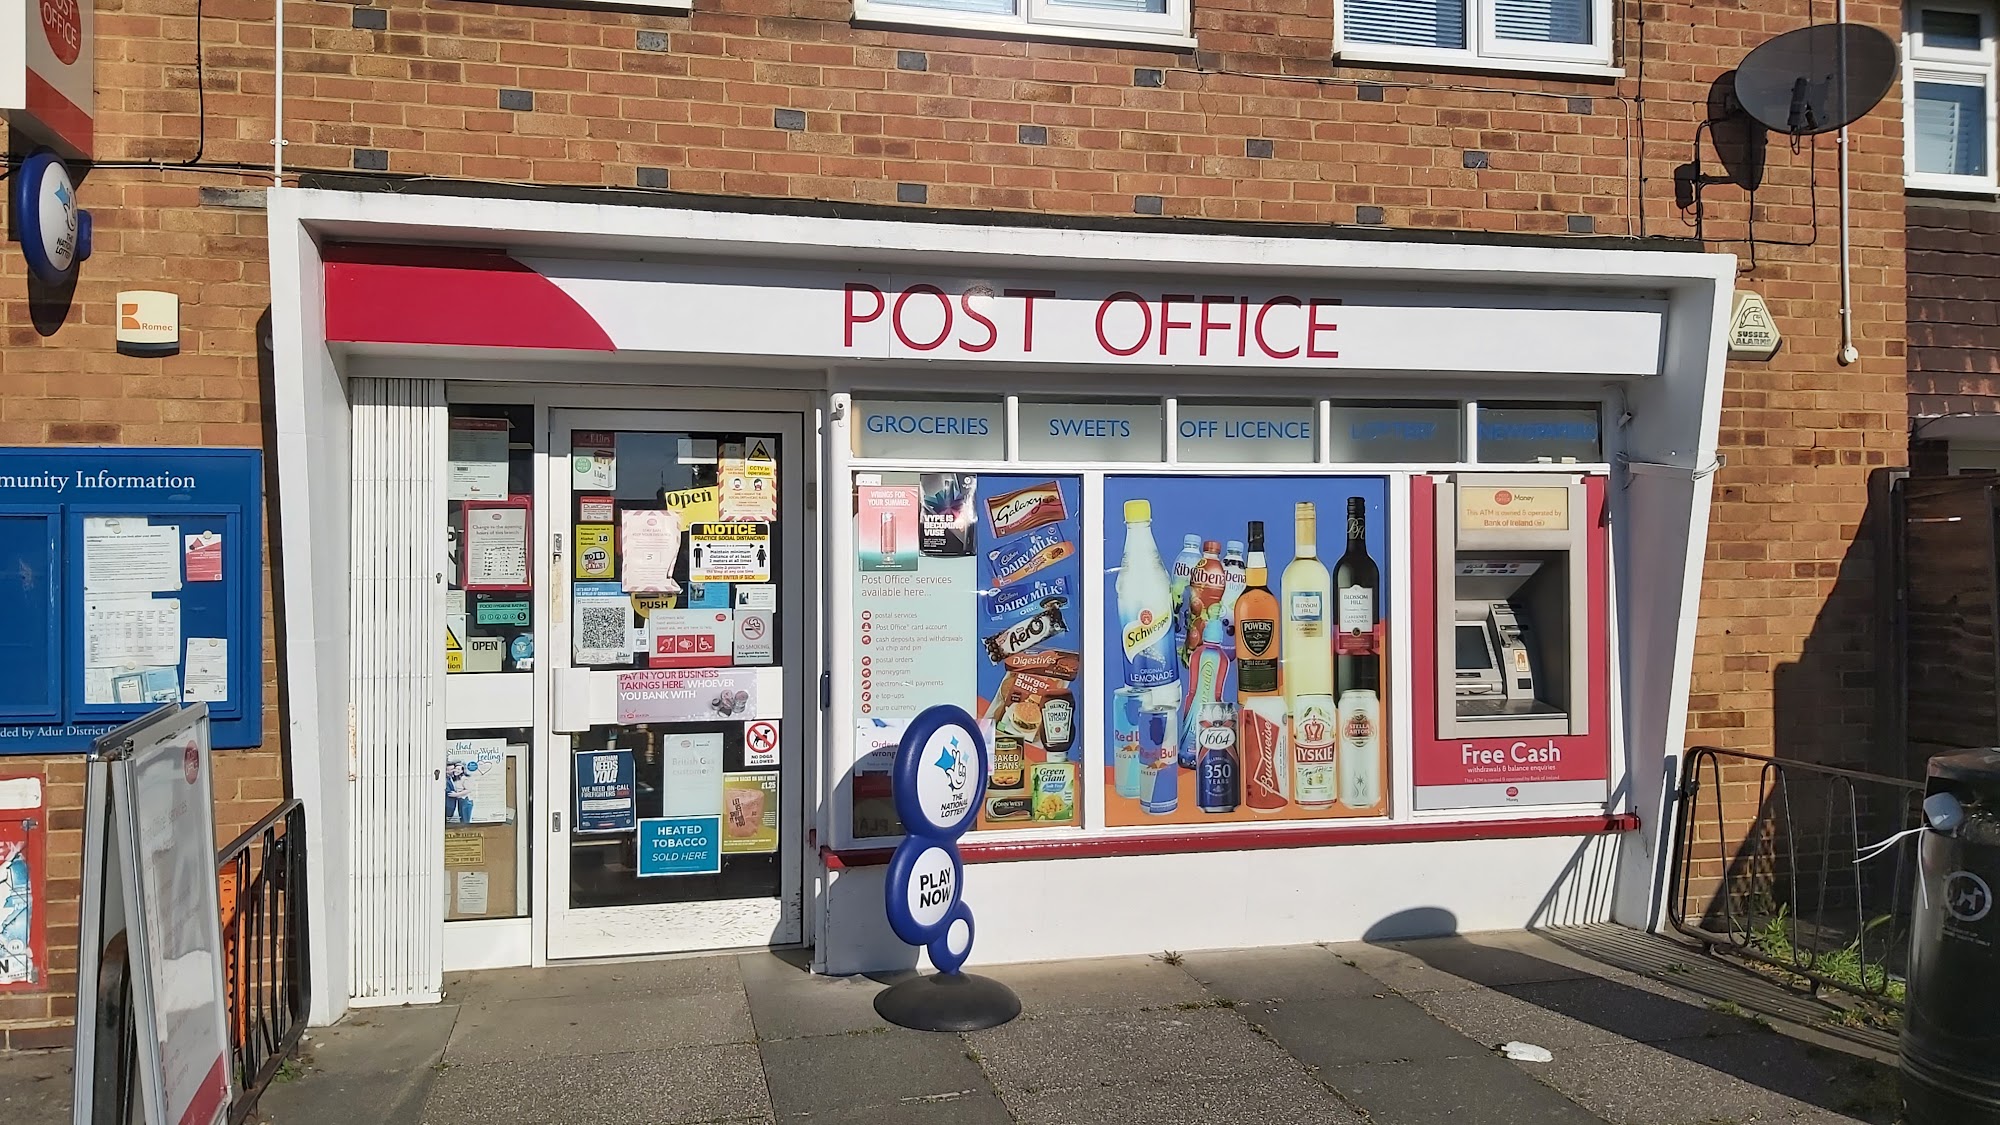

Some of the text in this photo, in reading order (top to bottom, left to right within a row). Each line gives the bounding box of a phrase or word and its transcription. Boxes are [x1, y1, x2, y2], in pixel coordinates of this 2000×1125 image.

[43, 2, 77, 50] OFFICE
[844, 282, 1342, 359] POST OFFICE
[142, 322, 173, 331] Romec
[866, 415, 989, 436] GROCERIES
[1049, 418, 1131, 438] SWEETS
[1179, 420, 1310, 439] OFF LICENCE
[75, 470, 196, 489] Information
[667, 489, 713, 508] Open
[1513, 494, 1535, 503] Money
[993, 495, 1043, 525] Galaxy
[1527, 509, 1554, 517] operated
[1554, 509, 1562, 517] by
[923, 514, 945, 522] VYPE
[1483, 519, 1533, 527] Bank of Ireland
[703, 524, 757, 535] NOTICE
[1000, 551, 1030, 577] DAIRY
[1029, 535, 1059, 558] MILK
[861, 575, 882, 585] Post
[915, 575, 952, 584] services
[1190, 569, 1225, 585] Ribena
[861, 587, 932, 597] available here...
[640, 600, 669, 609] PUSH
[994, 586, 1063, 614] DAIRY MILK
[875, 611, 918, 620] postal services
[911, 623, 924, 631] card
[925, 623, 948, 631] account
[1244, 622, 1272, 632] POWERS
[891, 636, 916, 644] deposits
[472, 641, 498, 651] OPEN
[885, 645, 899, 653] chip
[875, 656, 914, 665] postal orders
[1012, 655, 1057, 667] Digestives
[619, 670, 719, 681] PAY IN YOUR BUSINESS
[875, 668, 911, 677] moneygram
[1130, 669, 1174, 682] LEMONADE
[1140, 667, 1163, 675] ORIGINAL
[620, 679, 734, 690] TAKINGS HERE, WHOEVER
[915, 679, 944, 687] payments
[1014, 679, 1039, 694] Buns
[1017, 672, 1050, 690] Burger
[620, 690, 696, 701] YOU BANK WITH
[881, 692, 905, 701] top-ups
[890, 704, 917, 713] currency
[21, 725, 34, 740] by
[36, 725, 64, 737] Adur
[66, 724, 106, 736] District
[1115, 729, 1133, 742] Red
[871, 740, 900, 749] Ordere
[1204, 733, 1231, 746] 1664
[447, 746, 499, 756] Slimming World
[455, 742, 472, 750] that
[871, 750, 896, 760] wrong
[1139, 745, 1177, 759] Red Bull
[1296, 744, 1334, 762] TYSKIE
[1462, 740, 1561, 765] Free Cash
[477, 752, 504, 764] feeling!
[672, 757, 698, 766] British
[994, 754, 1019, 762] BAKED
[1259, 720, 1273, 797] Budweise
[594, 760, 619, 771] NEEDS
[994, 762, 1019, 770] BEANS
[1467, 765, 1502, 773] withdrawals
[1530, 764, 1556, 773] enquiries
[593, 770, 618, 784] YOU!
[1039, 768, 1065, 776] Green
[1204, 764, 1231, 779] 350
[1041, 774, 1066, 783] Giant
[761, 782, 776, 790] £1.25
[581, 790, 616, 798] FIREFIGHTERS
[952, 792, 964, 801] THE
[940, 798, 968, 811] NATIONAL
[657, 825, 702, 836] HEATED
[652, 837, 707, 848] TOBACCO
[652, 851, 708, 862] SOLD HERE
[919, 866, 952, 891] PLAY
[919, 885, 951, 908] NOW
